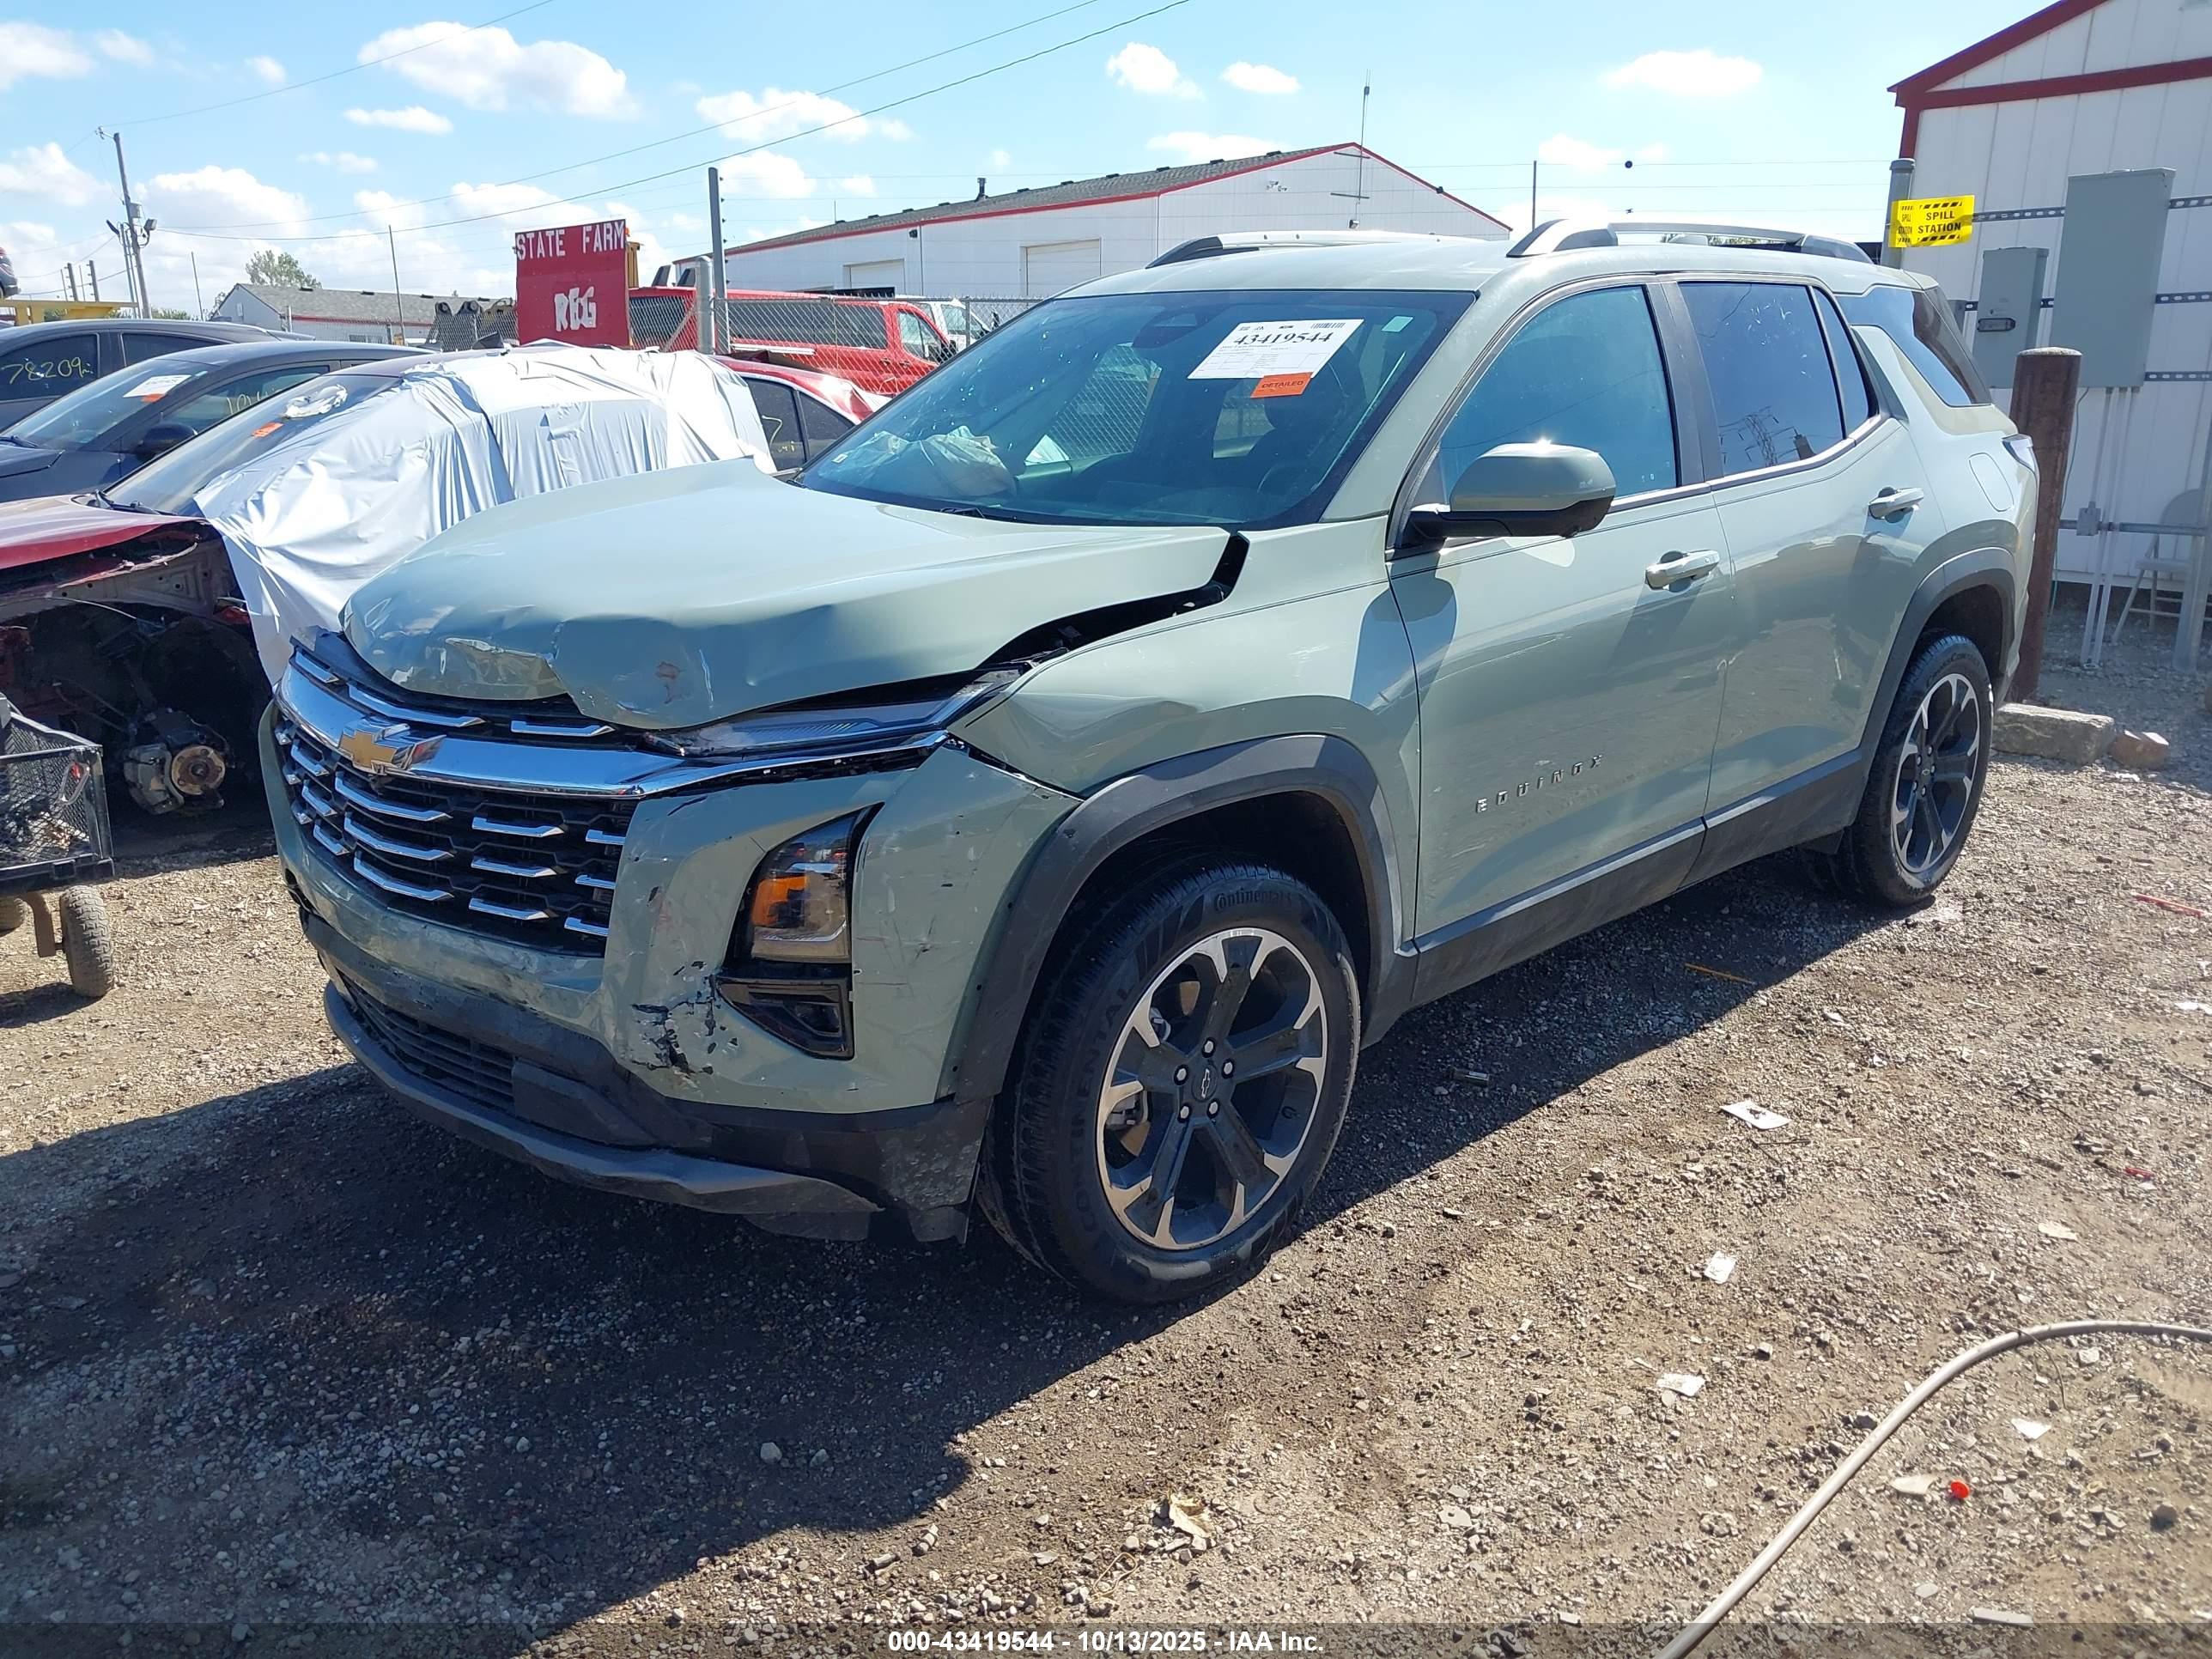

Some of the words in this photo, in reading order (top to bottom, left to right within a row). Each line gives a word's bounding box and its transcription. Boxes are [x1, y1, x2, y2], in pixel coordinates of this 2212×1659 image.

[1926, 210, 1955, 221] SPILL
[1917, 222, 1962, 234] STATION
[515, 228, 566, 261] STATE
[582, 221, 625, 254] FARM
[1233, 331, 1334, 345] 43419544
[1261, 380, 1304, 389] DETAILED
[1475, 754, 1603, 814] EQUINOX
